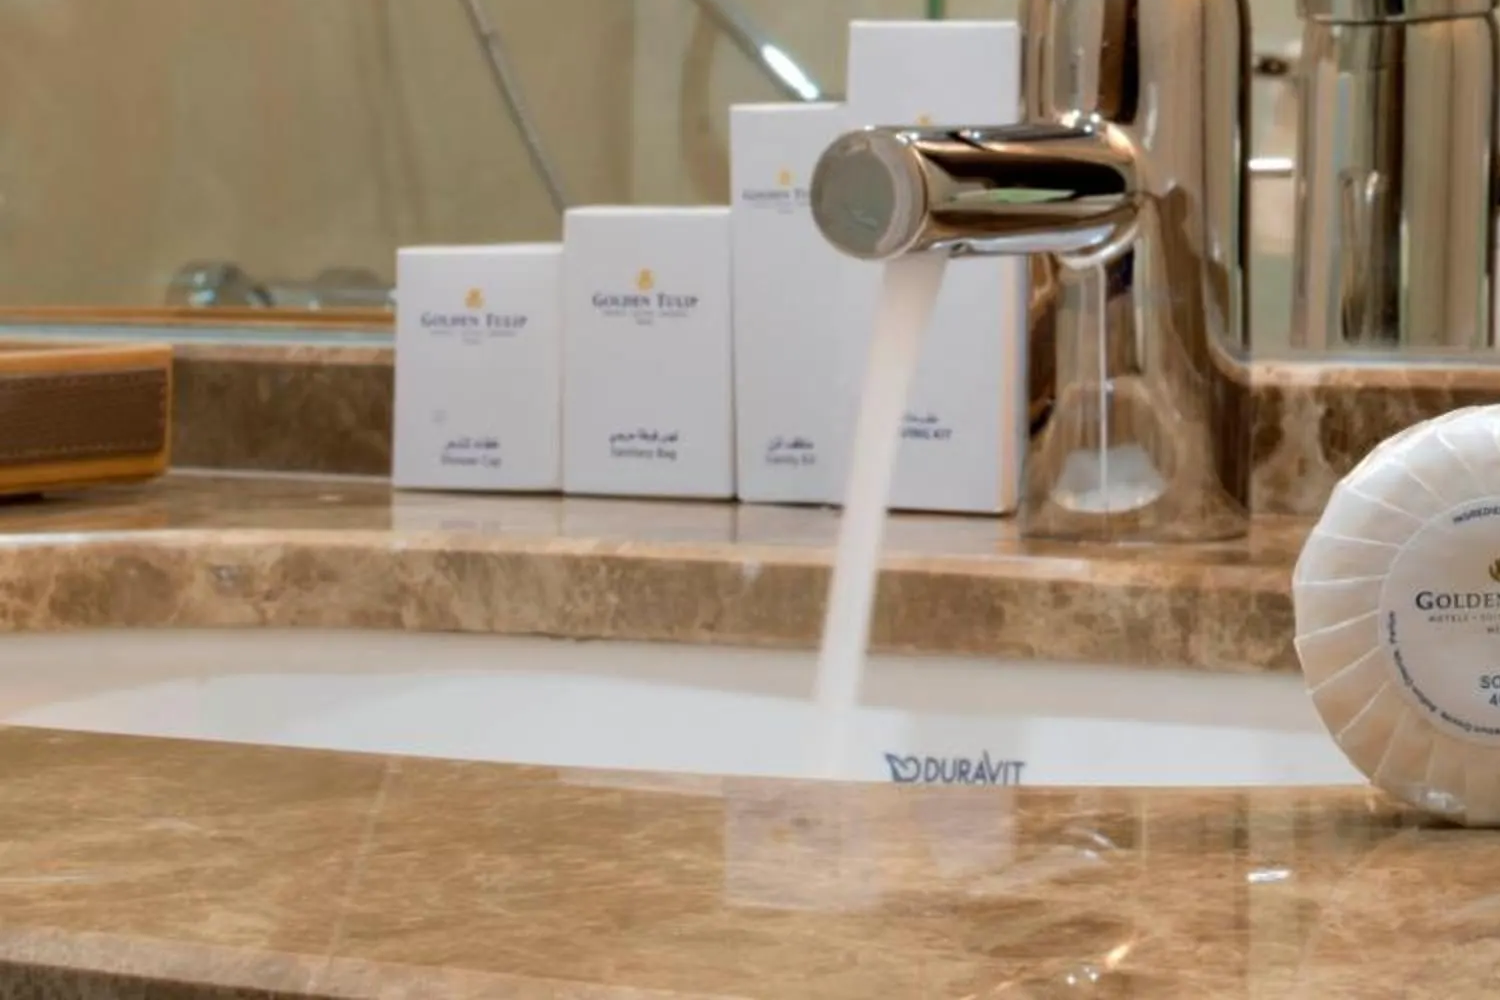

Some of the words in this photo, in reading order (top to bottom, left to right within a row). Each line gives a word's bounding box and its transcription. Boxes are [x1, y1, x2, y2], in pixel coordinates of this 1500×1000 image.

[592, 291, 651, 308] GOLDEN
[656, 291, 699, 308] TULIP
[420, 311, 480, 328] GOLDEN
[924, 749, 1026, 786] DURAVIT
